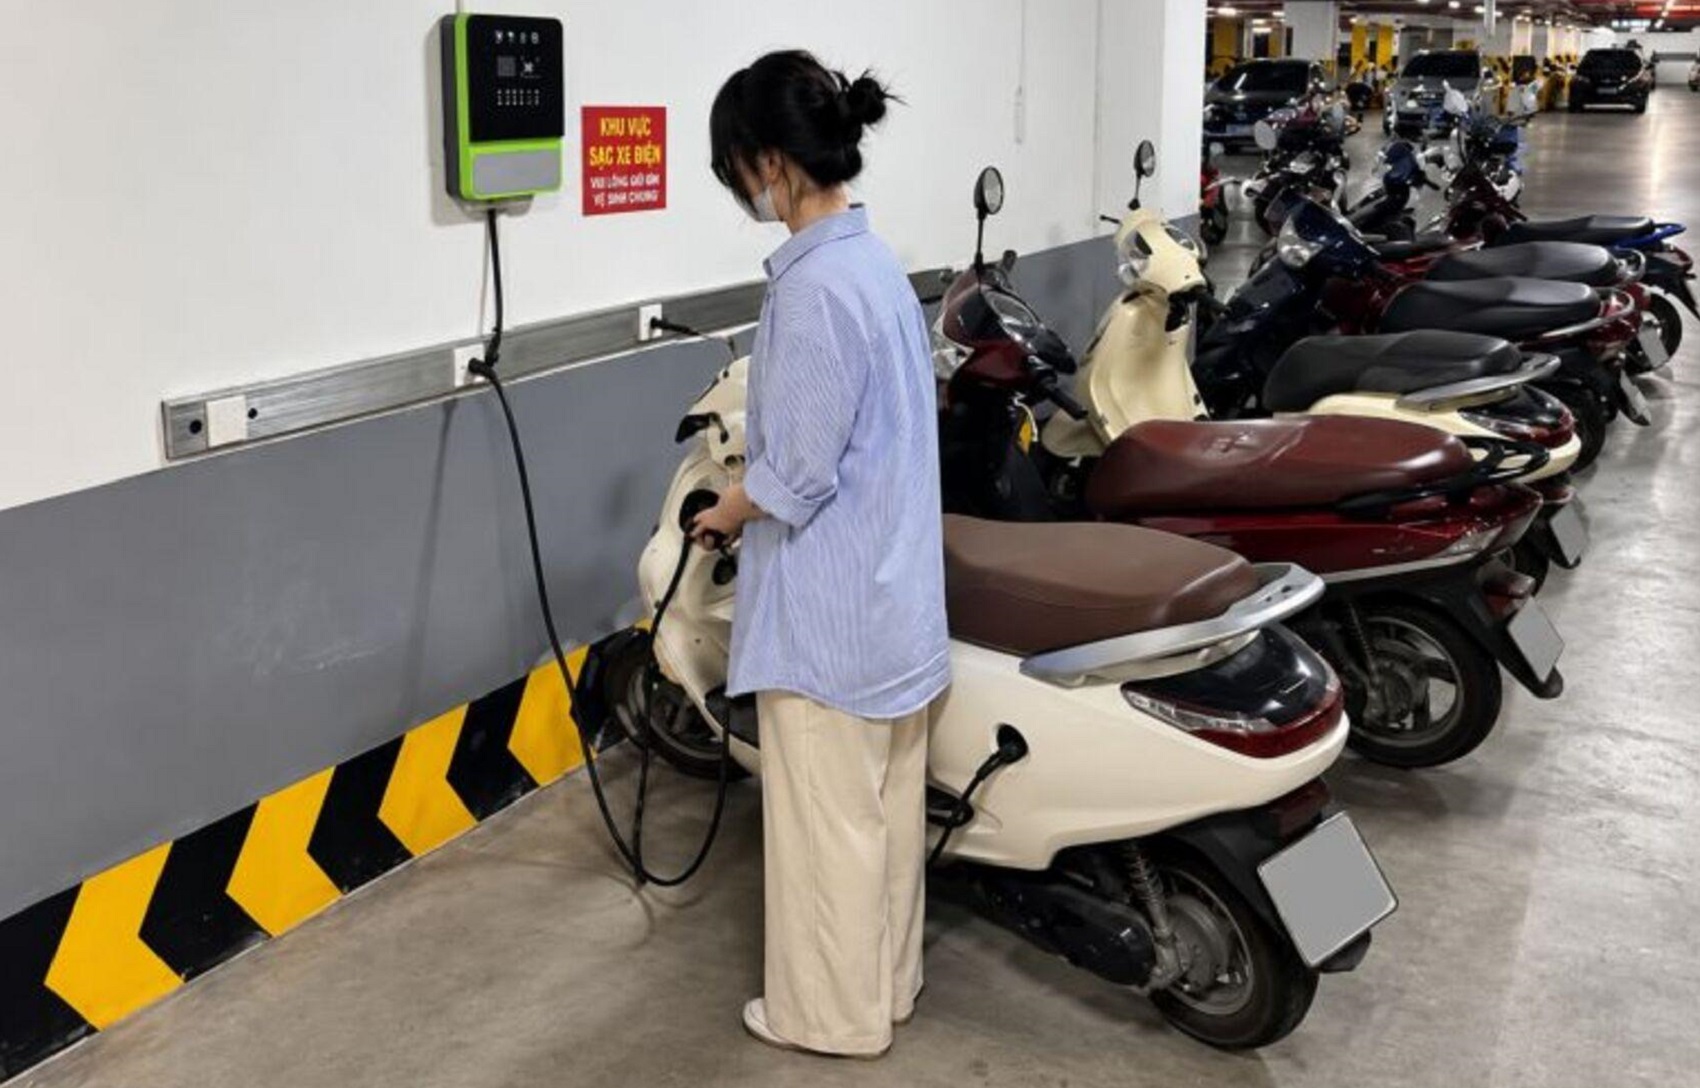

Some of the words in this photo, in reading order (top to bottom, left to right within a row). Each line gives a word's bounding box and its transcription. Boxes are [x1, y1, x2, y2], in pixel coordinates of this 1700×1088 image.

[600, 117, 624, 136] KHU
[590, 146, 613, 170] SẠC
[617, 145, 631, 165] XE
